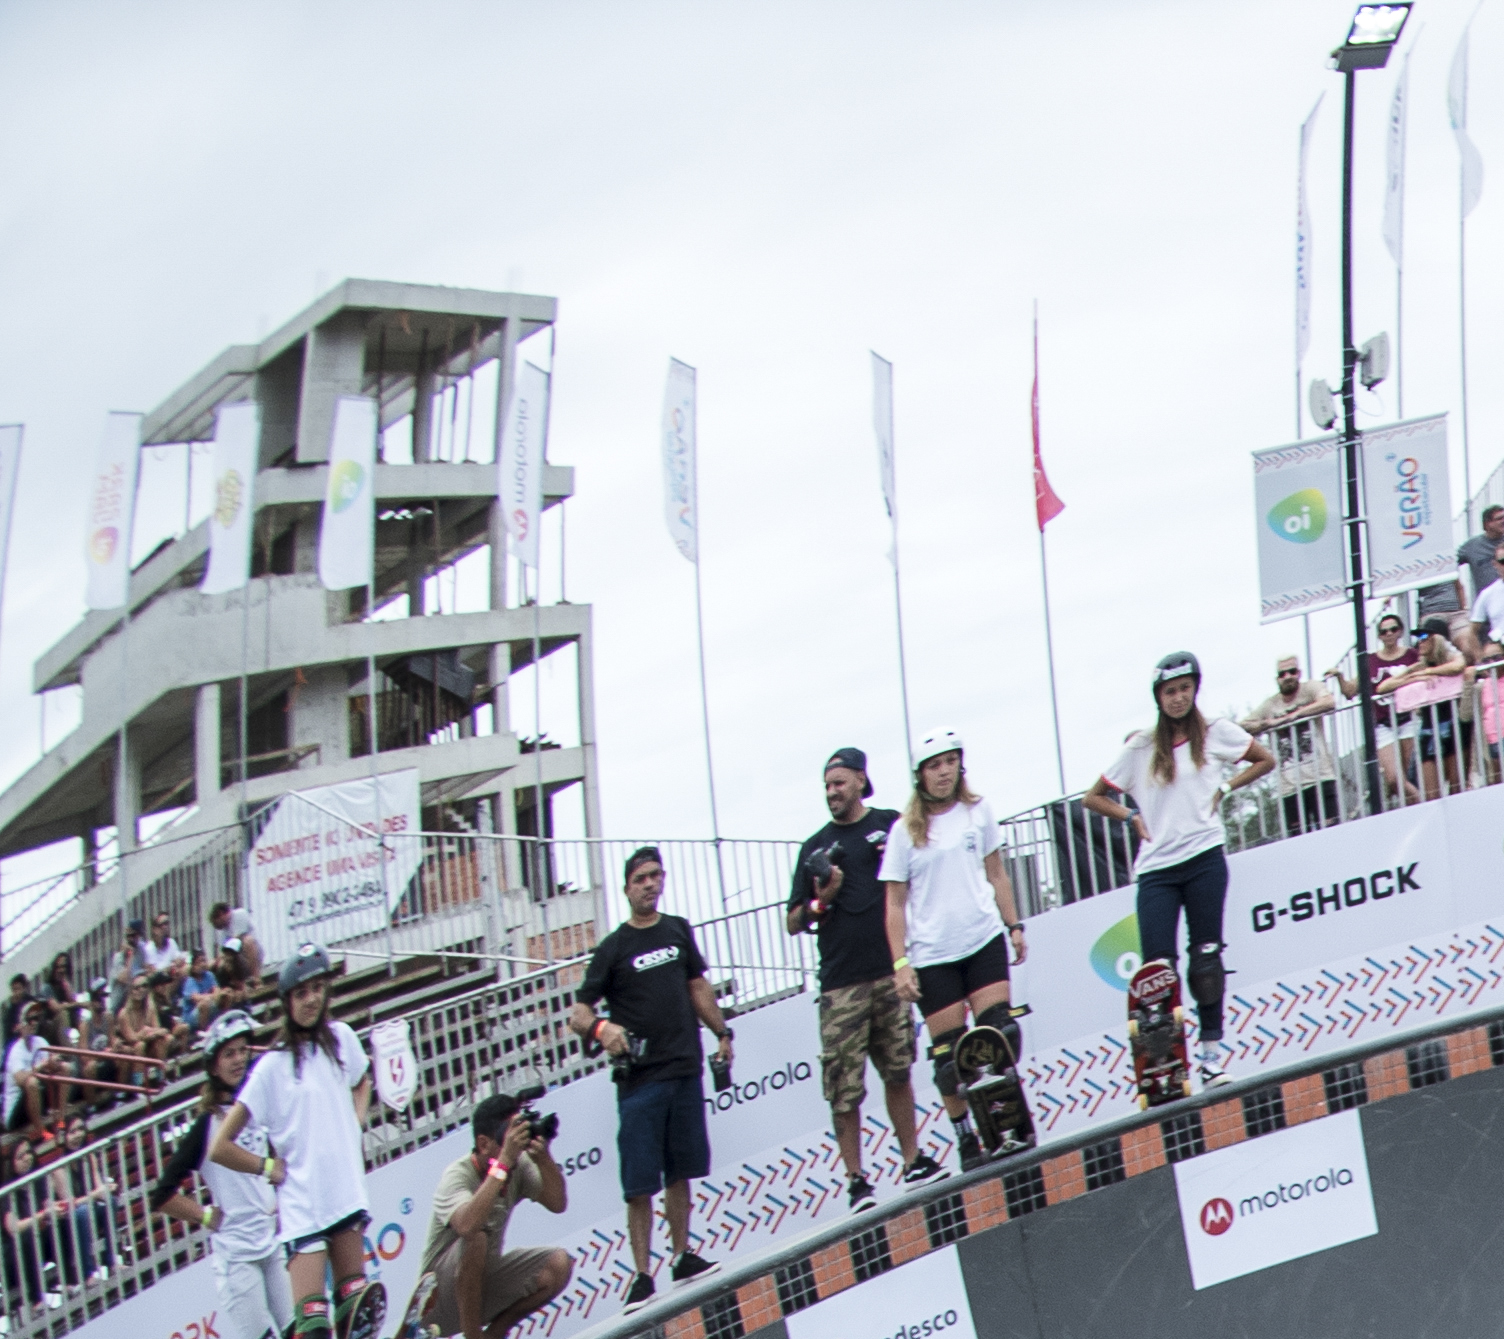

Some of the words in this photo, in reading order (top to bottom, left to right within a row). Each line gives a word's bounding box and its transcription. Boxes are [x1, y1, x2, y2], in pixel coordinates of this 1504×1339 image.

[1283, 504, 1311, 534] oi
[1394, 456, 1424, 550] VERÃO
[1251, 861, 1422, 933] G-SHOCK
[1130, 969, 1177, 998] VANS
[1238, 1166, 1354, 1218] motorola
